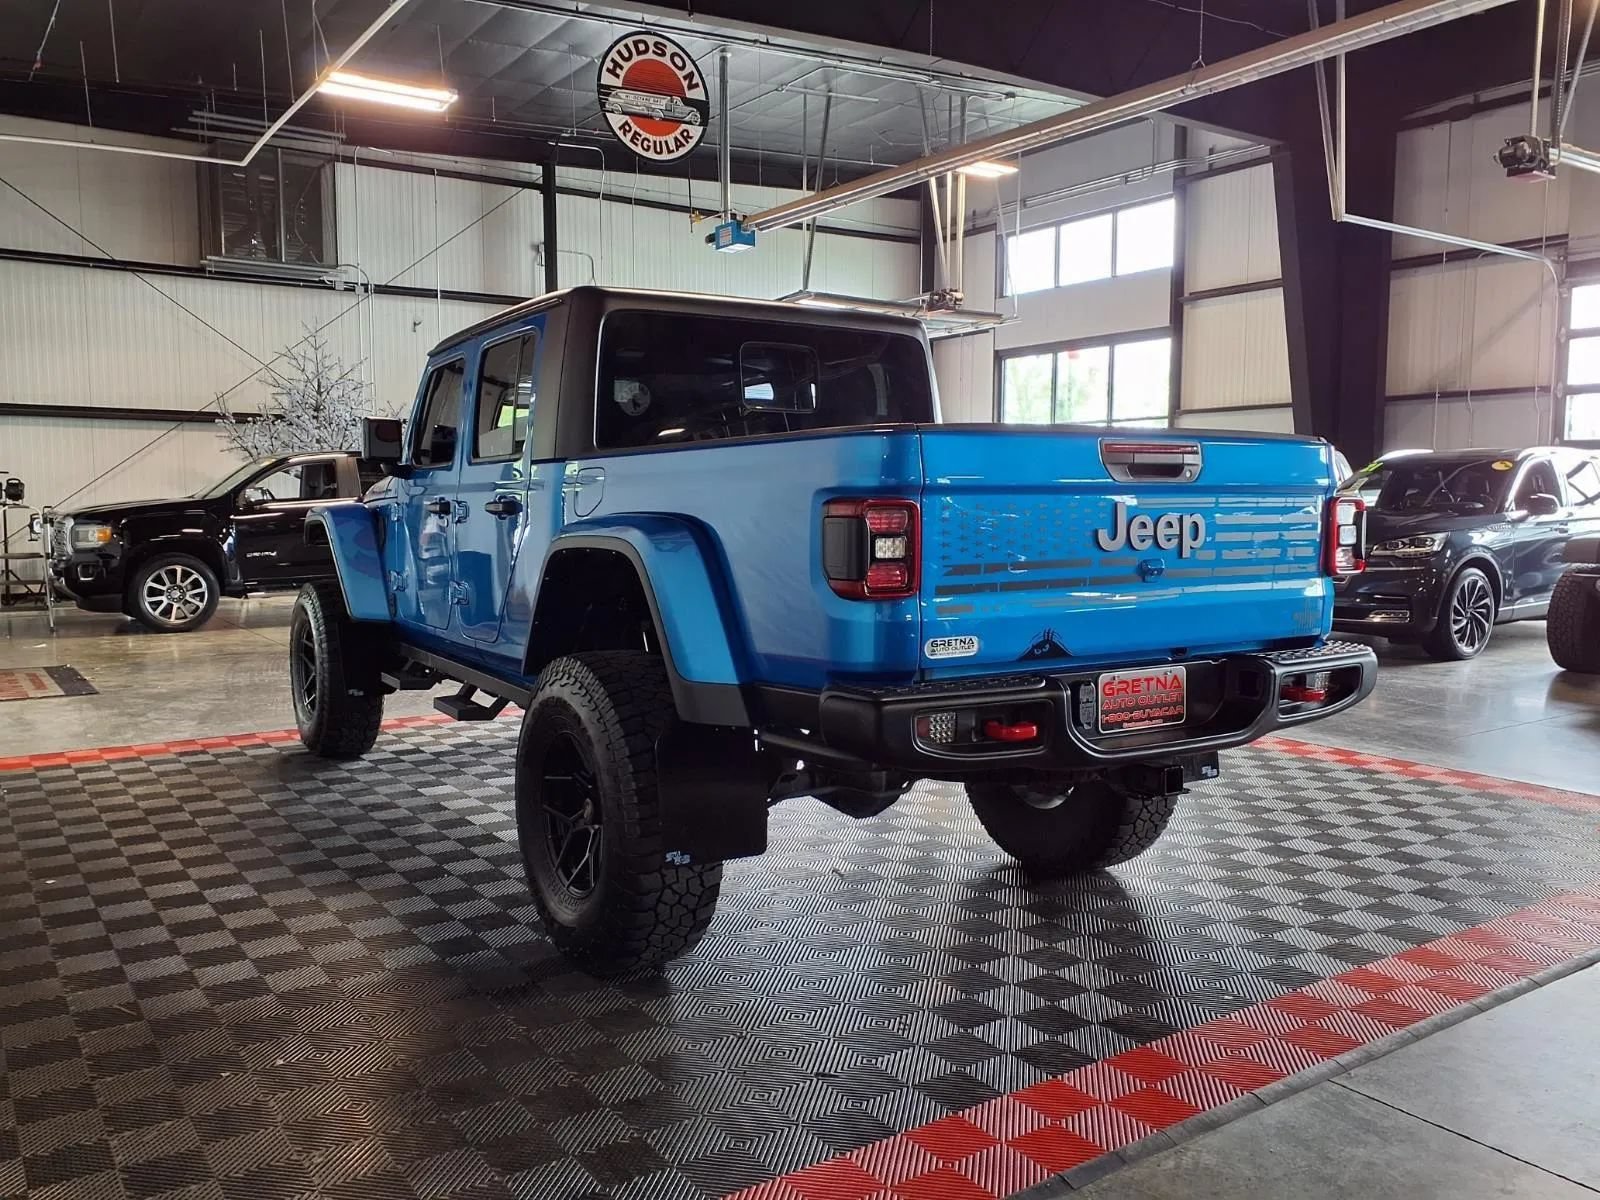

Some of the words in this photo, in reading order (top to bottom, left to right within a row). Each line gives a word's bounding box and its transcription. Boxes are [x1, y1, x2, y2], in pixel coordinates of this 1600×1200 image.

[606, 39, 699, 91] HUDSON
[618, 120, 694, 155] REGULAR
[1097, 501, 1206, 558] Jeep
[931, 638, 974, 647] GRETNA
[1103, 675, 1182, 697] GRETNA
[1103, 698, 1136, 710] AUTO
[1138, 693, 1183, 705] OUTLET
